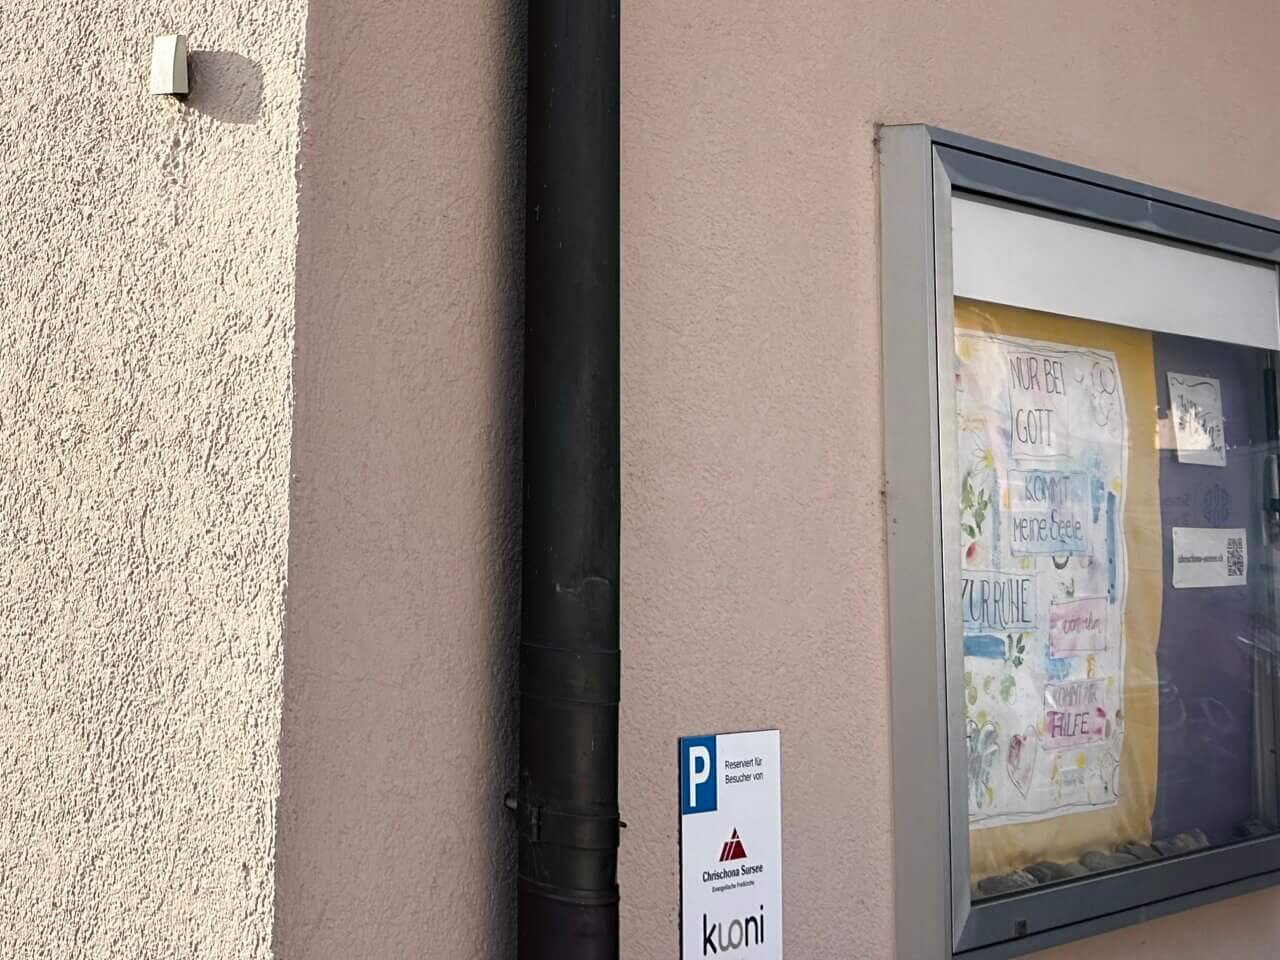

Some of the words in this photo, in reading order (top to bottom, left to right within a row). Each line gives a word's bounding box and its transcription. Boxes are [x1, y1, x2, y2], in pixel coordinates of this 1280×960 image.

[1009, 356, 1041, 391] NUR
[1043, 358, 1066, 396] BEI
[1015, 408, 1055, 447] GOTT
[688, 745, 712, 808] P
[724, 758, 754, 770] Reserviert
[724, 773, 752, 785] Besucher
[752, 772, 764, 782] von
[702, 867, 740, 883] Chrischona
[740, 864, 764, 877] Sursee
